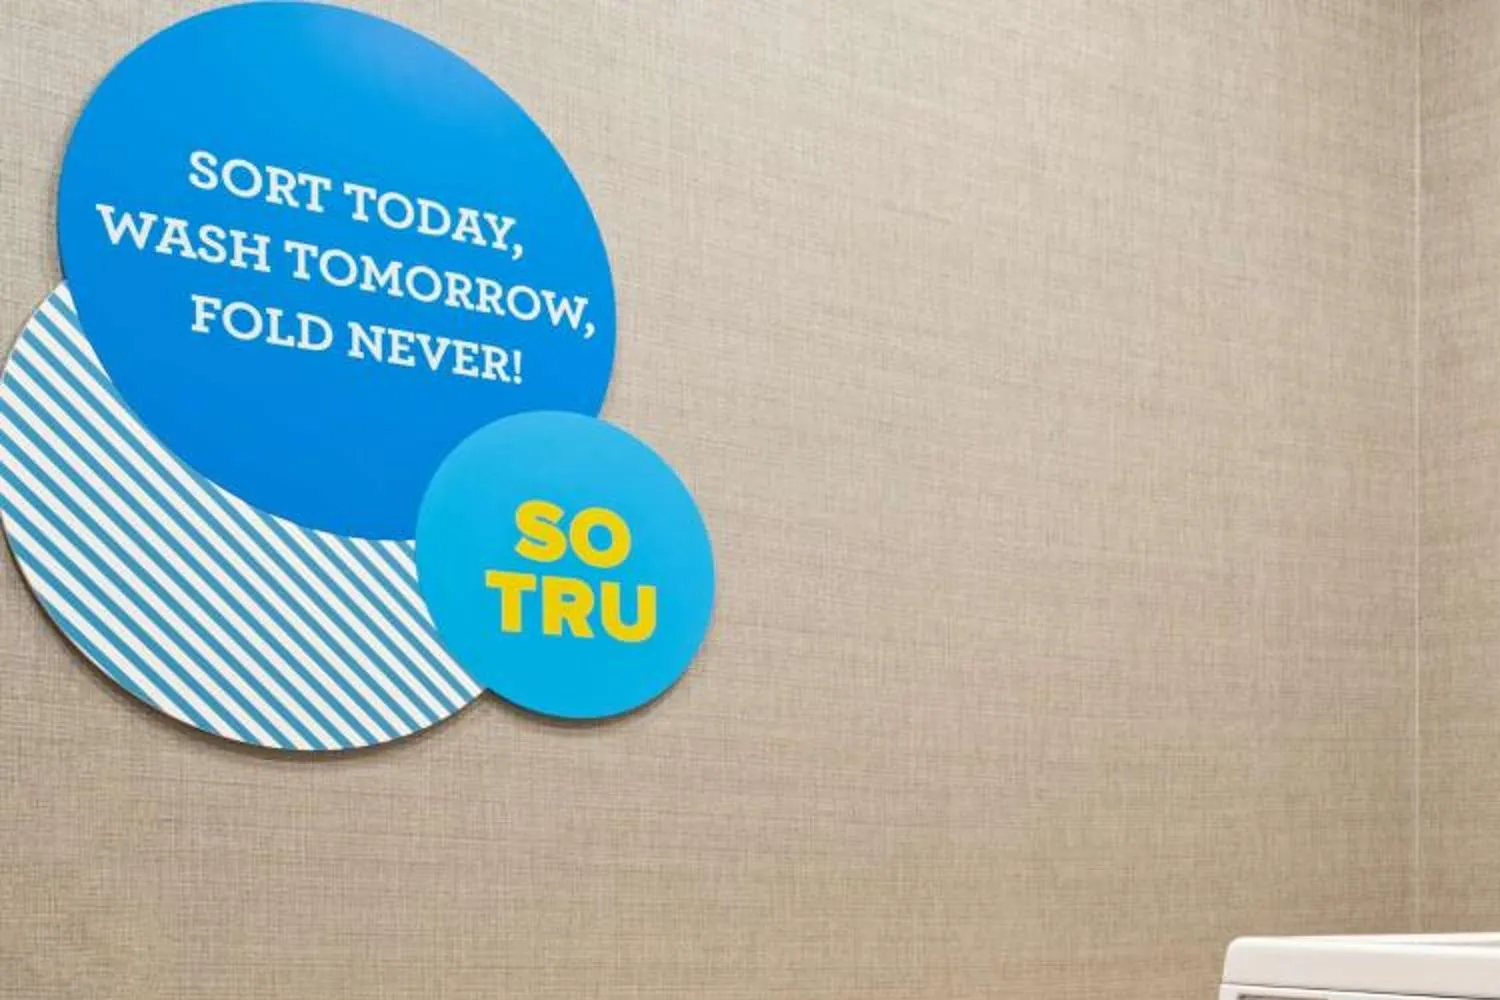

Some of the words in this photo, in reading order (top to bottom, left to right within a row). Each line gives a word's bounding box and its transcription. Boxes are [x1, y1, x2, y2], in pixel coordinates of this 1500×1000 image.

[188, 150, 332, 213] SORT
[343, 182, 524, 260] TODAY,
[95, 203, 270, 273] WASH
[284, 240, 597, 339] TOMORROW,
[190, 294, 333, 352] FOLD
[348, 322, 523, 385] NEVER!
[514, 500, 631, 567] SO
[485, 570, 657, 643] TRU
